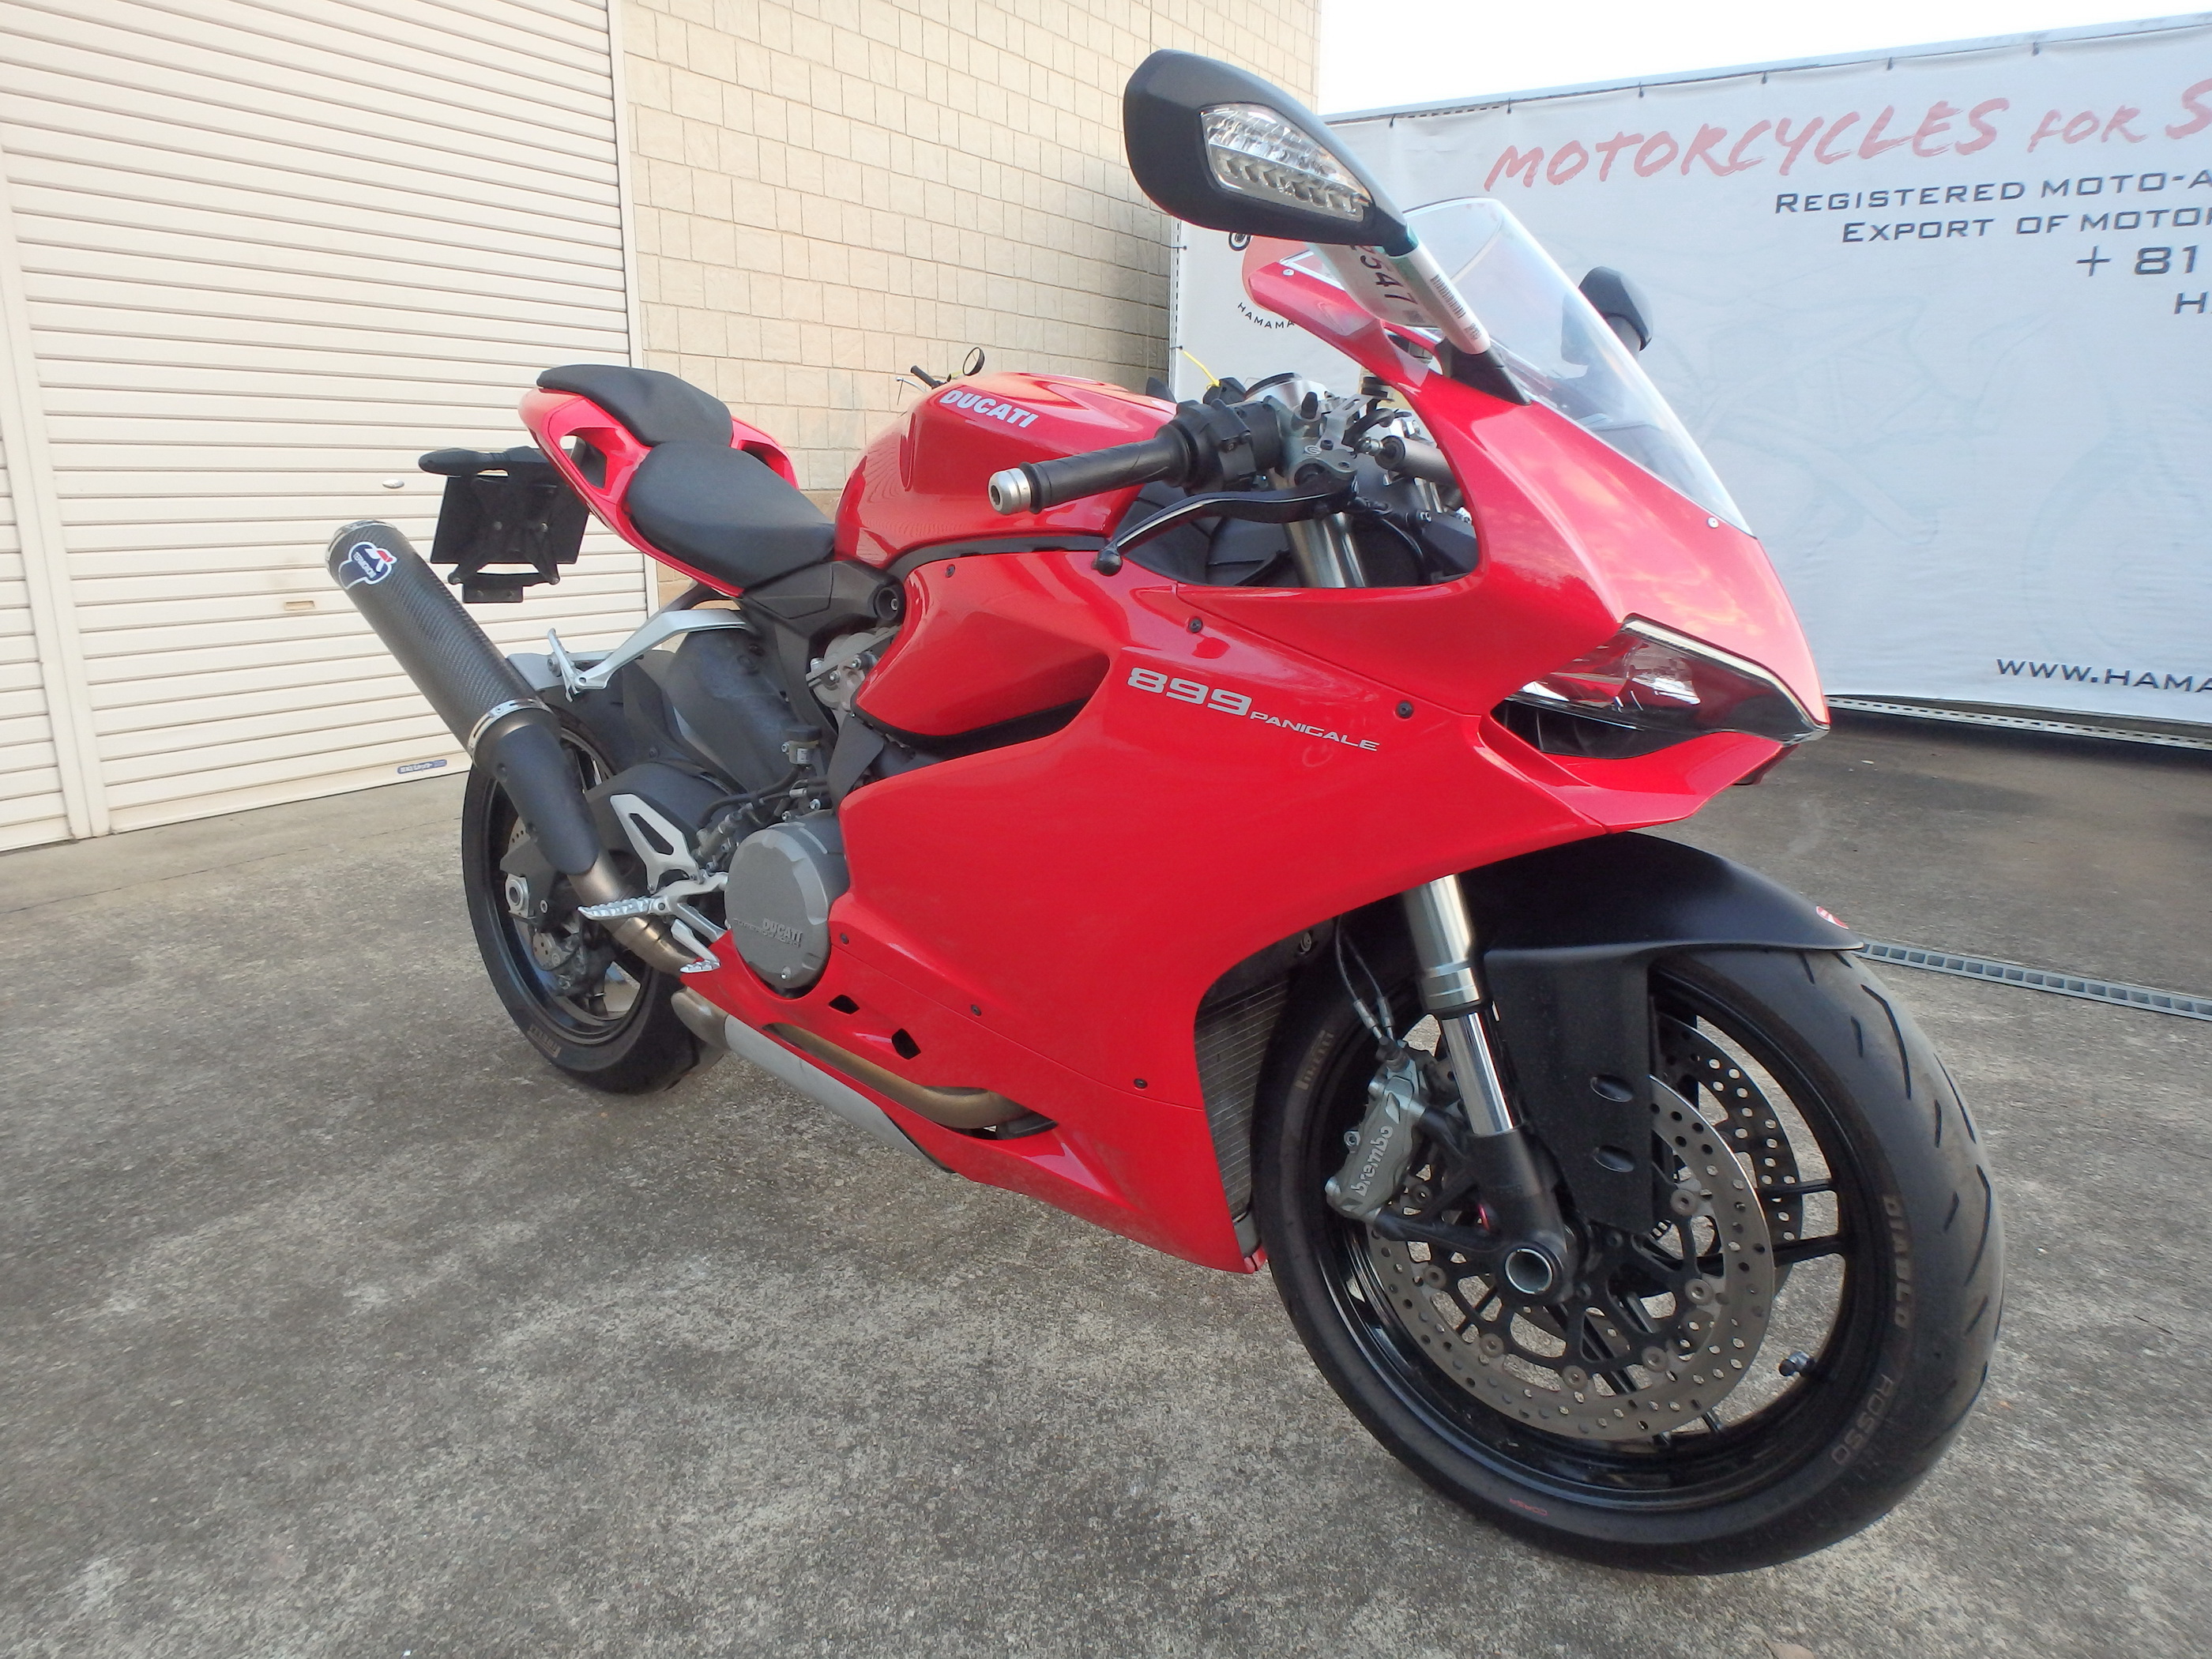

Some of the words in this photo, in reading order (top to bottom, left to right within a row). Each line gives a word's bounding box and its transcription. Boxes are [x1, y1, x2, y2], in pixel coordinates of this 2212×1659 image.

[1484, 97, 2010, 193] MOTORCYCLES
[1775, 181, 2026, 214] REGISTERED
[1842, 217, 1996, 243] EXPORT
[2016, 214, 2070, 235] OF
[2135, 245, 2199, 275] 81
[939, 389, 1040, 428] DUCATI
[1127, 667, 1253, 717] 899
[1250, 711, 1380, 751] PANIGALE
[762, 917, 803, 943] DUCATI
[1351, 1126, 1394, 1197] brembo
